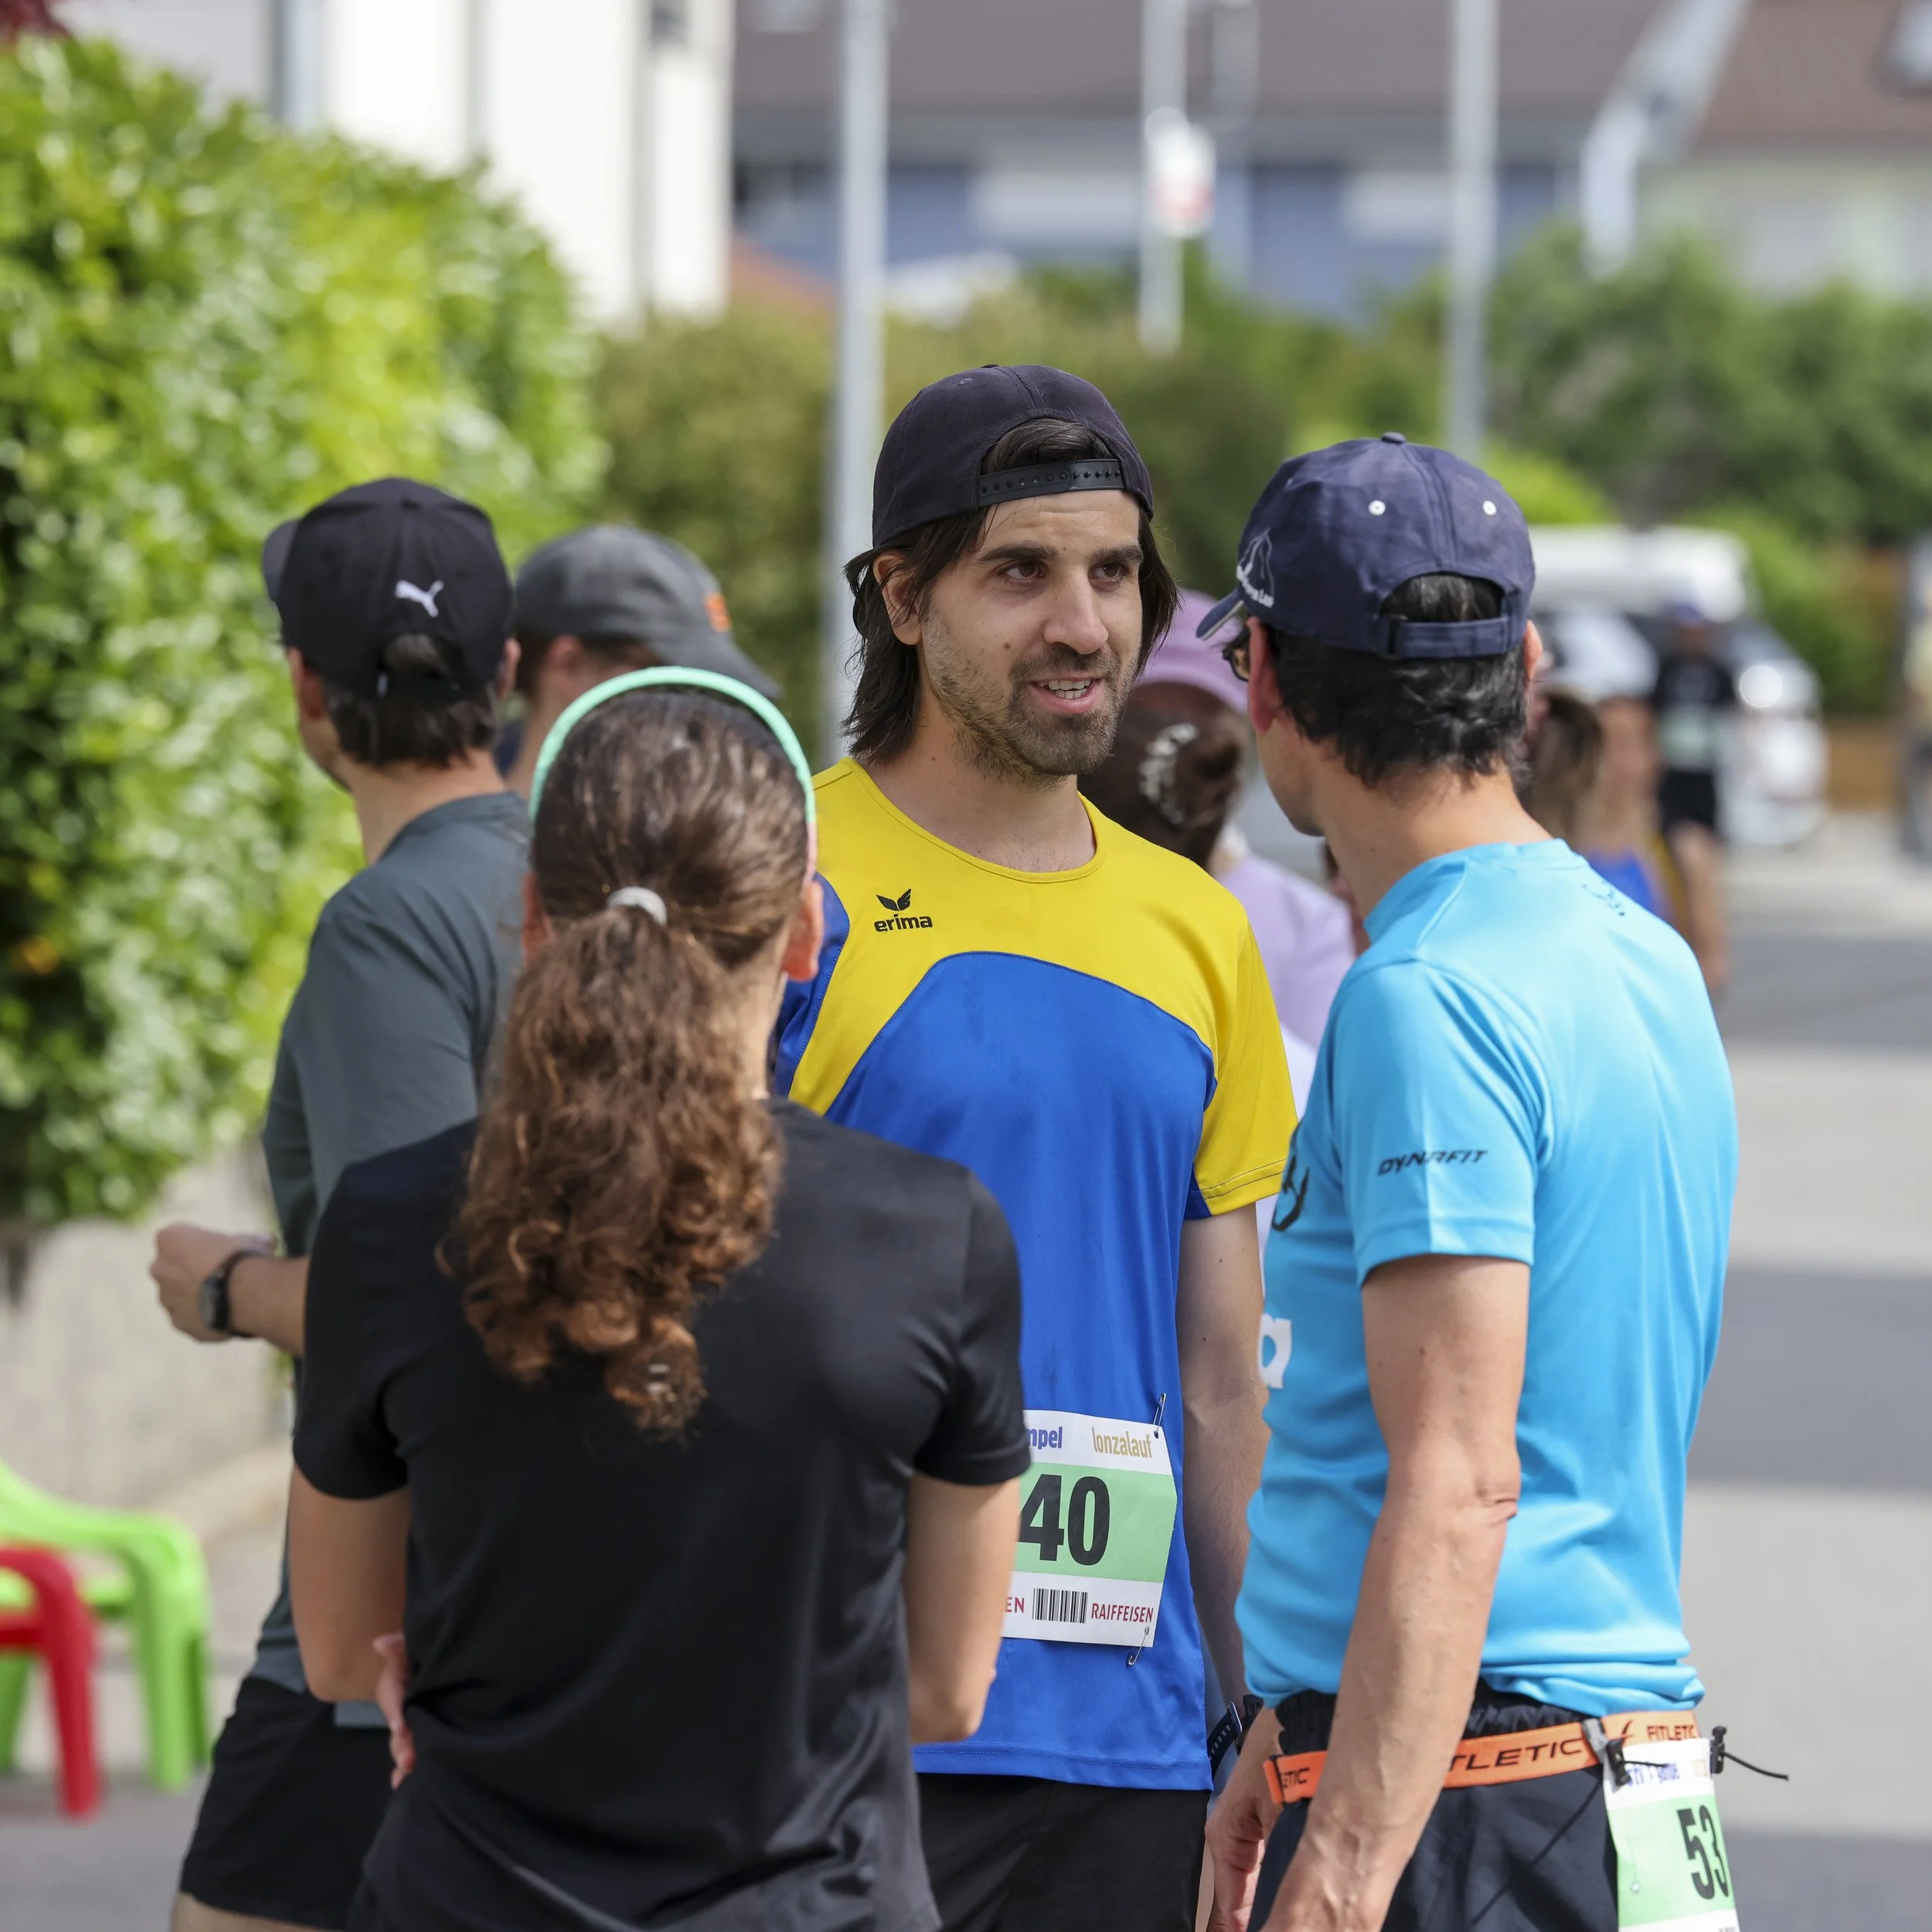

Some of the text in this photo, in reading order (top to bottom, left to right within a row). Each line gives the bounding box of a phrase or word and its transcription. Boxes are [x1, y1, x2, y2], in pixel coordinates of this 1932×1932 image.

[874, 913, 933, 932] erima
[1378, 1150, 1488, 1176] DYNAFIT
[1091, 1427, 1152, 1458] lonzalauf
[1090, 1603, 1154, 1623] RAIFFEISEN
